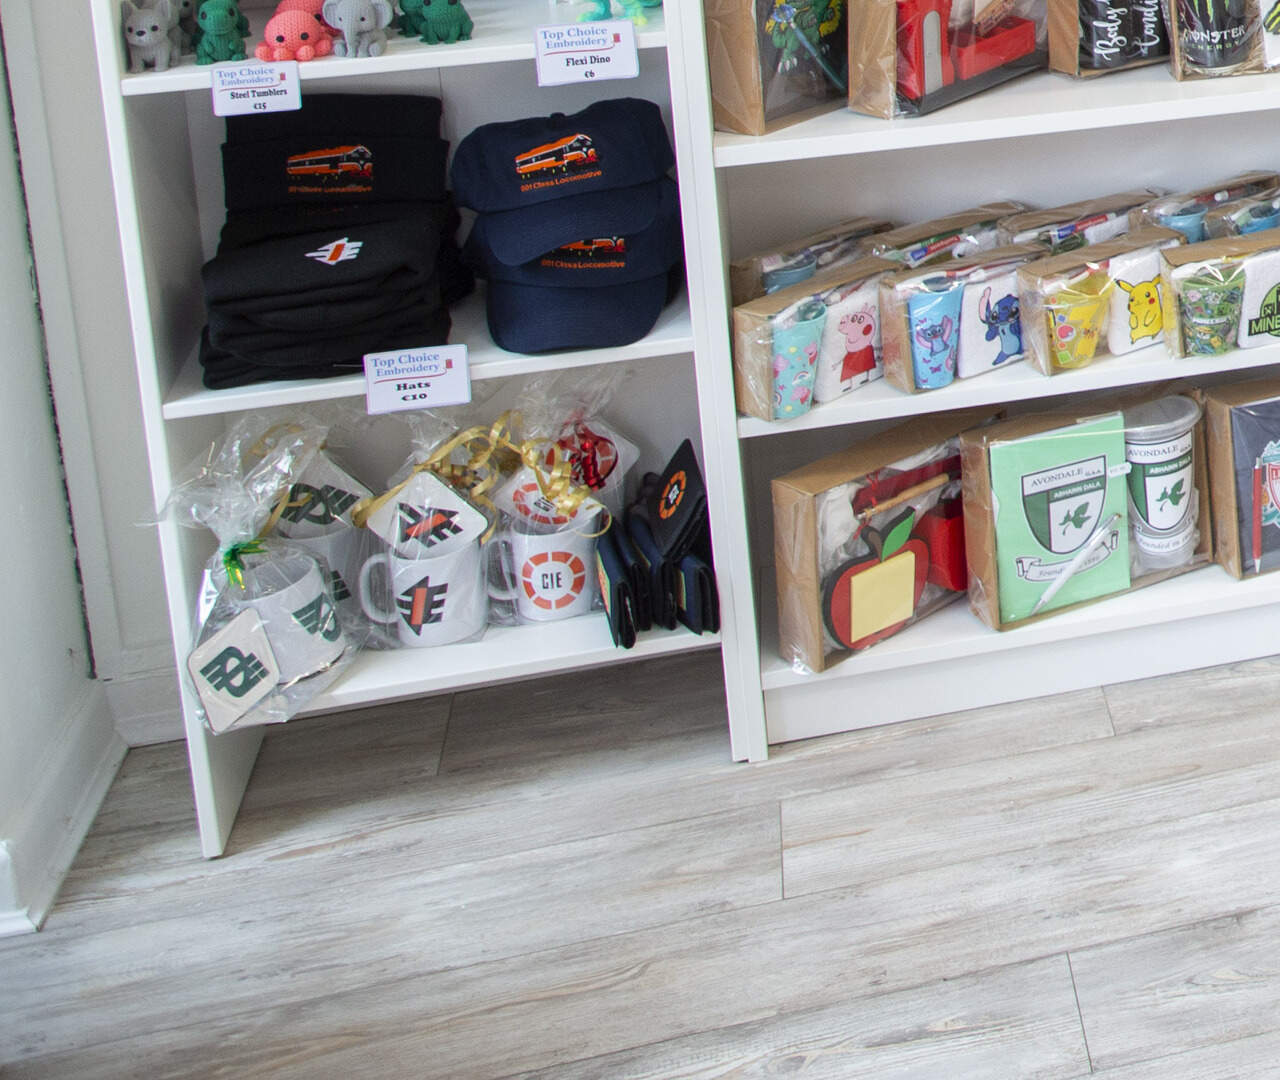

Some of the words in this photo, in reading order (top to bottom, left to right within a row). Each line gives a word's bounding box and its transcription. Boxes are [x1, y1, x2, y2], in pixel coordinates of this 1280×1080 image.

[542, 30, 564, 40] Top
[567, 26, 608, 37] Choice
[1093, 7, 1127, 60] Body
[1182, 25, 1246, 44] MONSTER
[546, 37, 608, 49] Embroidery
[566, 57, 588, 67] Flexi
[590, 55, 611, 65] Dino
[218, 71, 237, 79] Top
[240, 68, 275, 77] Choice
[221, 76, 274, 87] Embroidery
[230, 91, 249, 100] Steel
[251, 88, 288, 98] Tumblers
[533, 178, 555, 190] Class
[555, 170, 602, 186] Locomotive
[372, 358, 395, 368] Top
[398, 352, 440, 364] Choice
[376, 364, 440, 377] Embroidery
[396, 382, 431, 392] Hats
[401, 393, 428, 401] €10
[1127, 444, 1179, 458] AVONDALE
[1031, 468, 1084, 488] AVONDALE
